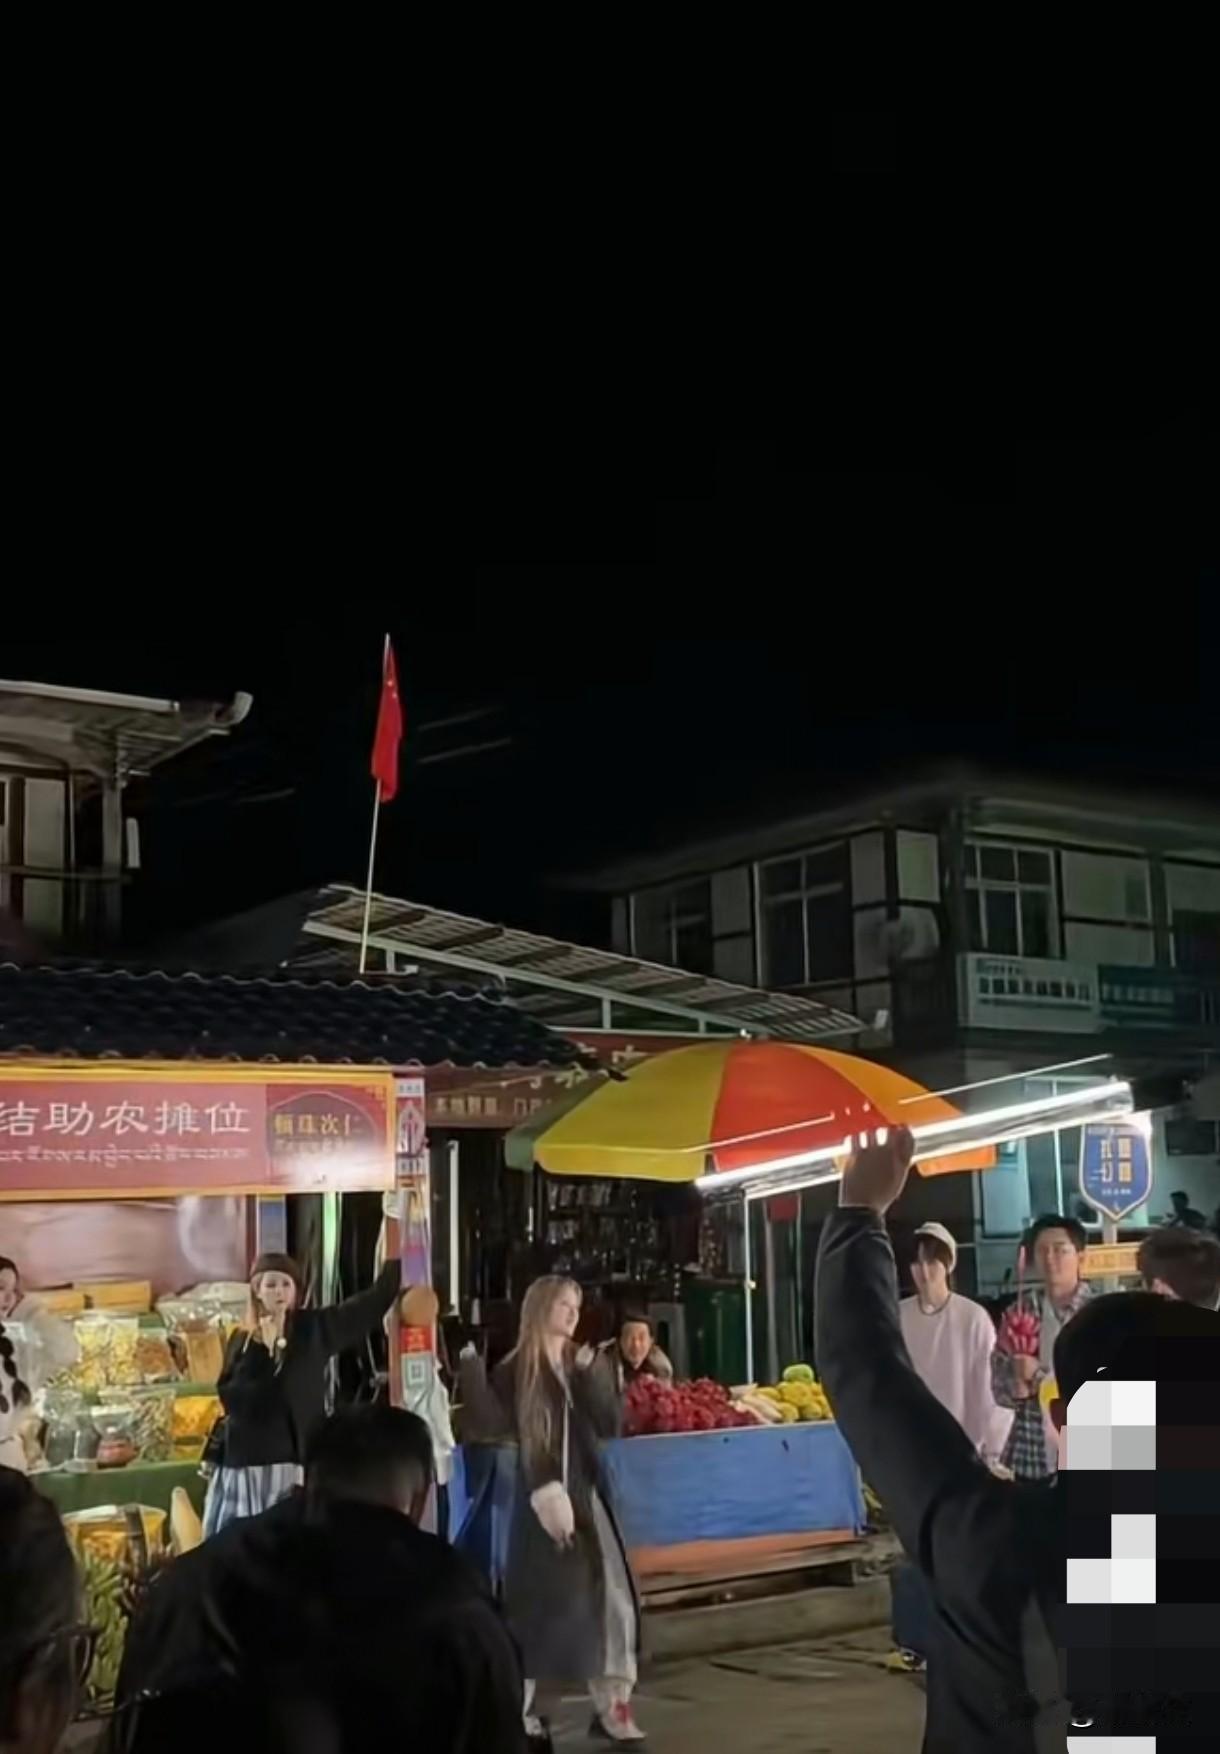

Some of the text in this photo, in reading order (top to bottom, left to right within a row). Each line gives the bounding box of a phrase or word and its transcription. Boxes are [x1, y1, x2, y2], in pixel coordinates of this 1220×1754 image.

[0, 1100, 250, 1136] 结助农摊位
